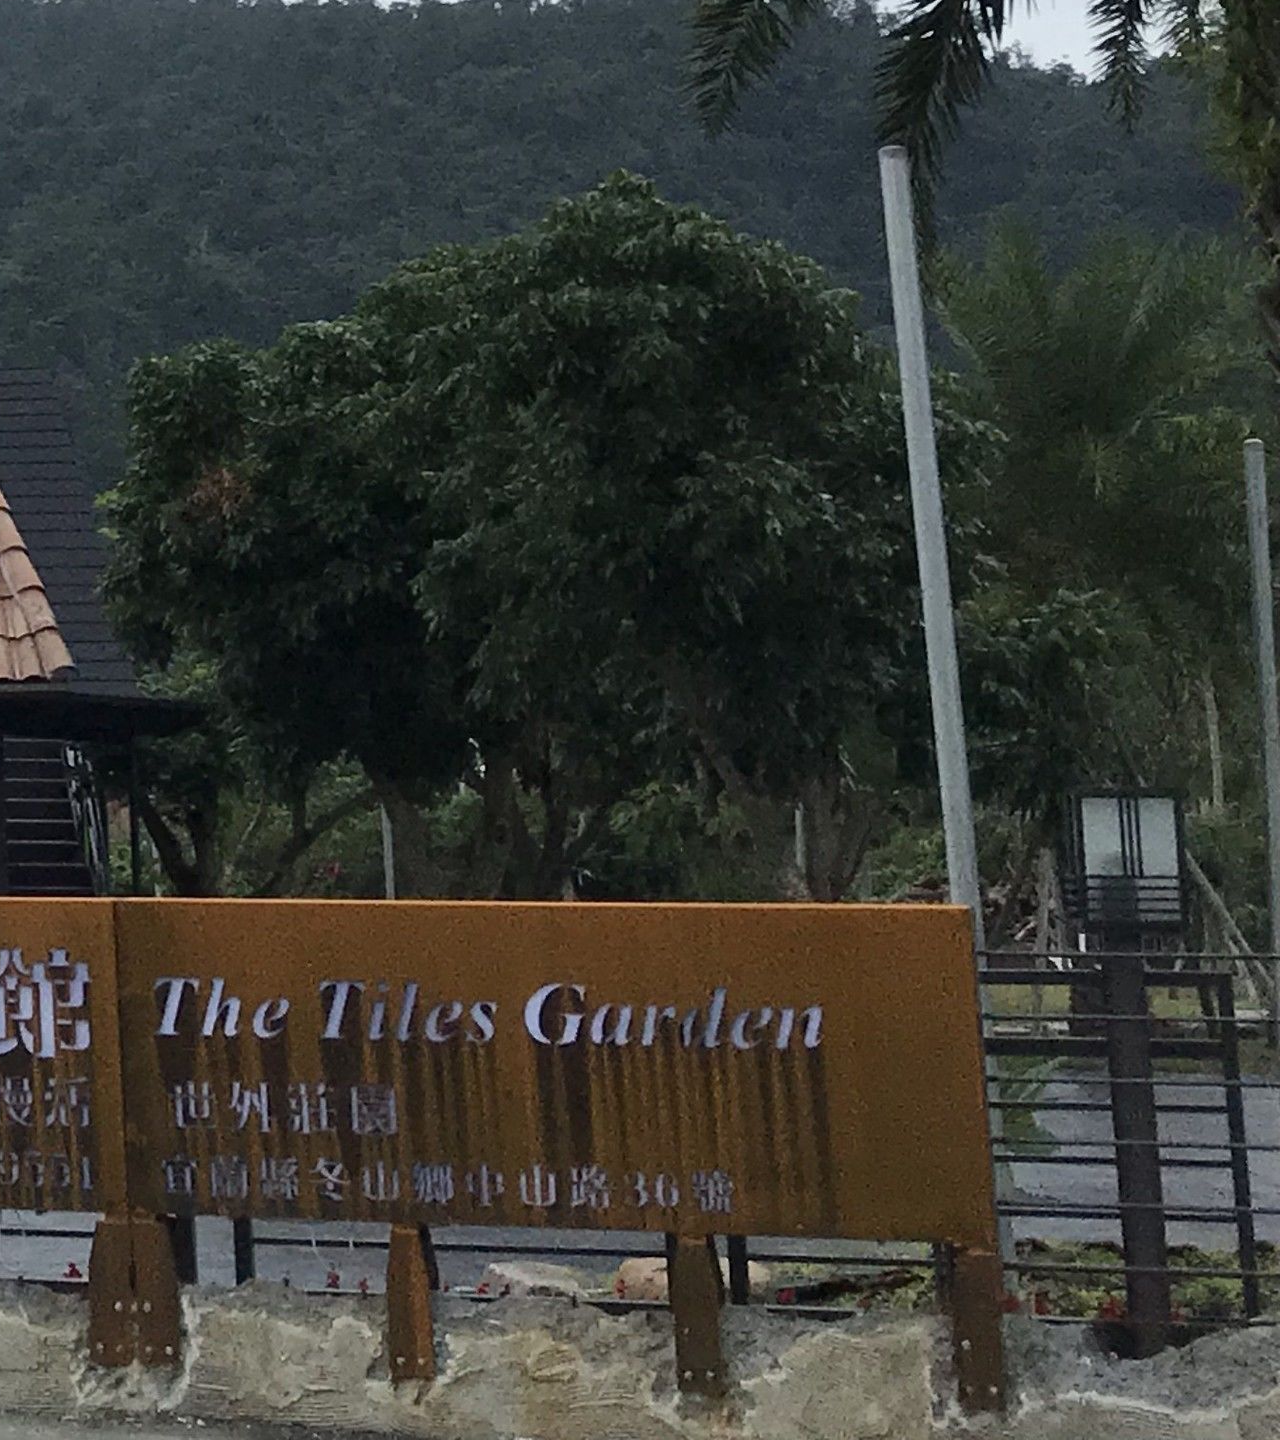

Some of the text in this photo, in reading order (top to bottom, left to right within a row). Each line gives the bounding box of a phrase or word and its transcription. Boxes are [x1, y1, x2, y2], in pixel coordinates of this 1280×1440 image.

[151, 976, 827, 1052] The Tiles Garden
